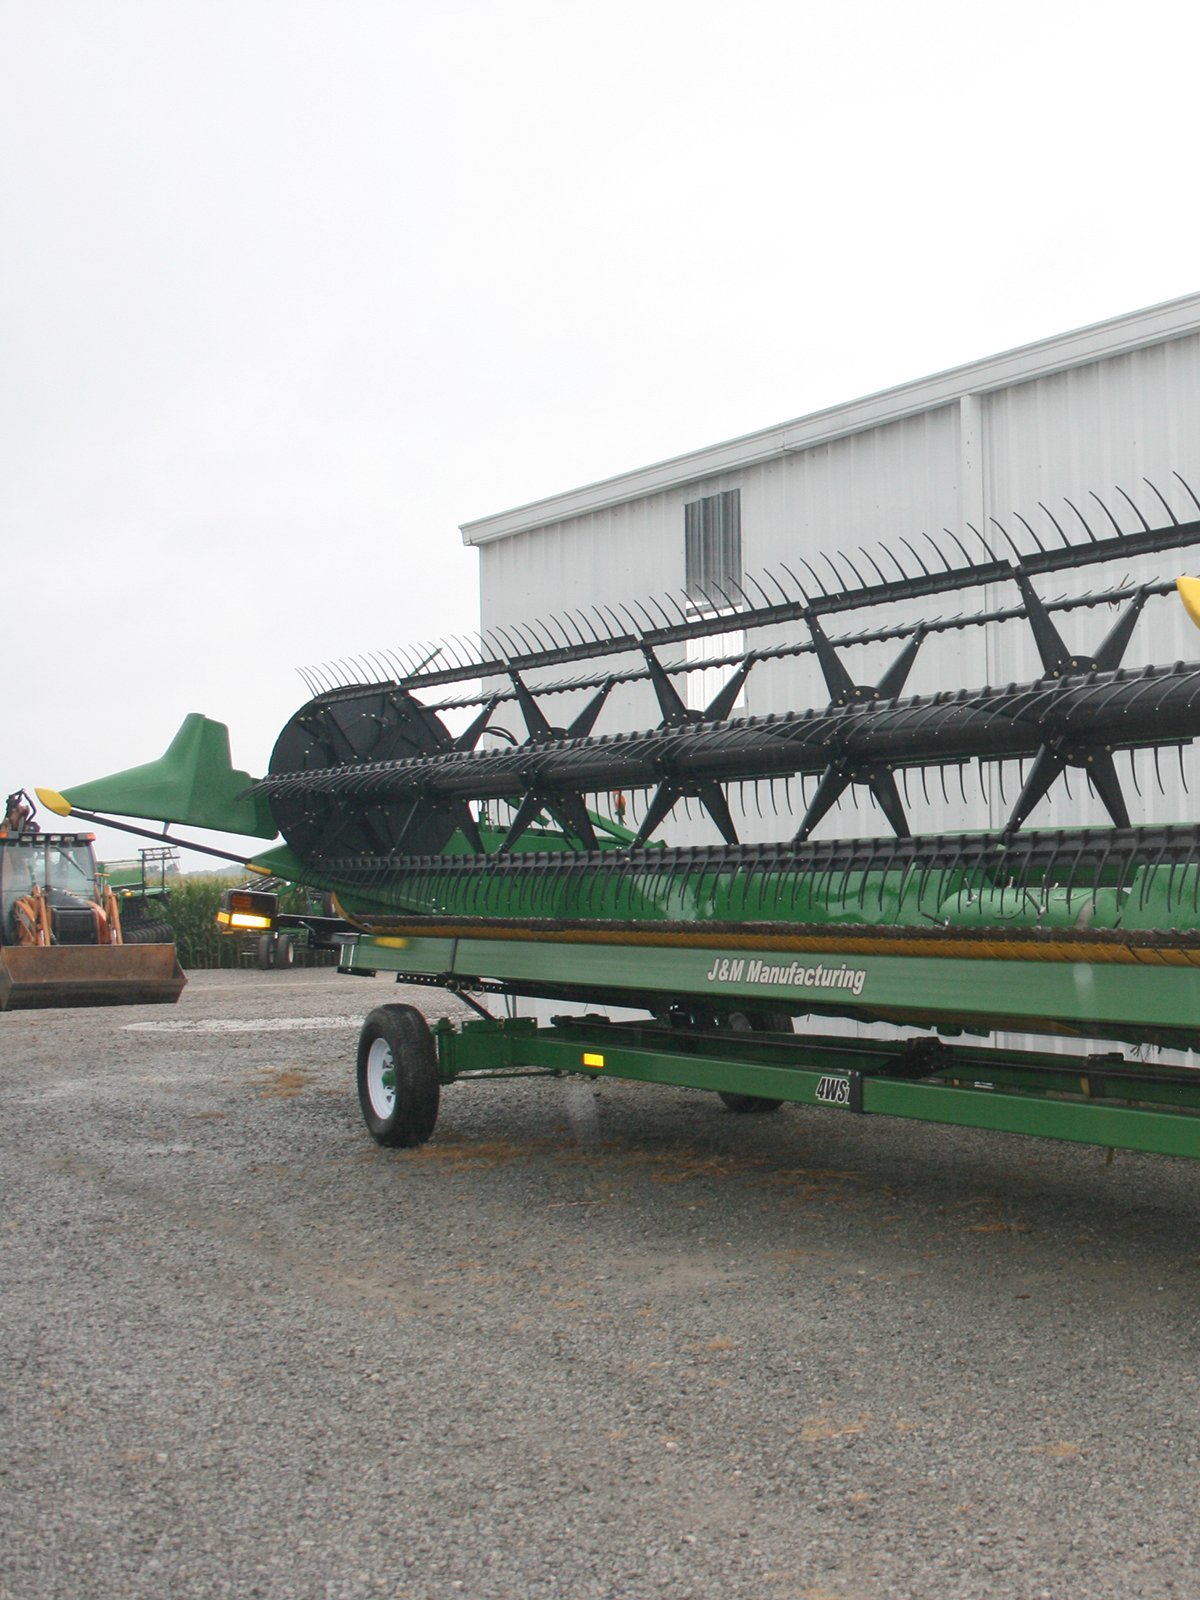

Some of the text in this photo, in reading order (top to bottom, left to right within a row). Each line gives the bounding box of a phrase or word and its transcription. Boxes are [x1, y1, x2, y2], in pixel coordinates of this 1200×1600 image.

[707, 957, 867, 995] J&M Manufacturing
[815, 1076, 850, 1104] 4WS
